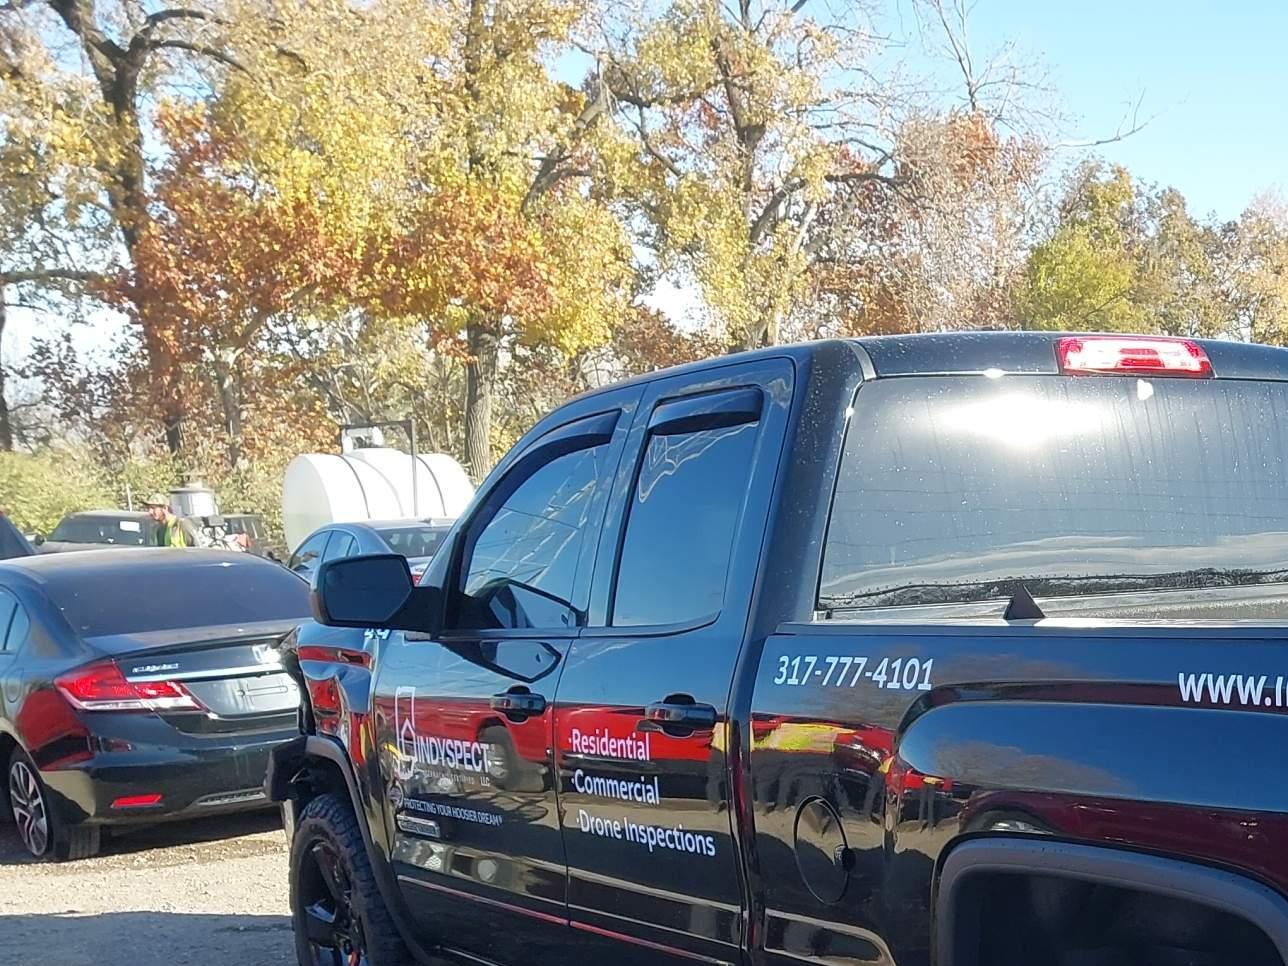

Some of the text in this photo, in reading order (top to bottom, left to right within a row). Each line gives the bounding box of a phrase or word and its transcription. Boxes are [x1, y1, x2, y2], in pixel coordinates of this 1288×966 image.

[773, 655, 934, 691] 317-777-4101
[404, 797, 436, 814] PROTECTING
[436, 804, 452, 817] YOUR
[452, 807, 477, 822] HOOSIER
[623, 817, 716, 857] Inspections
